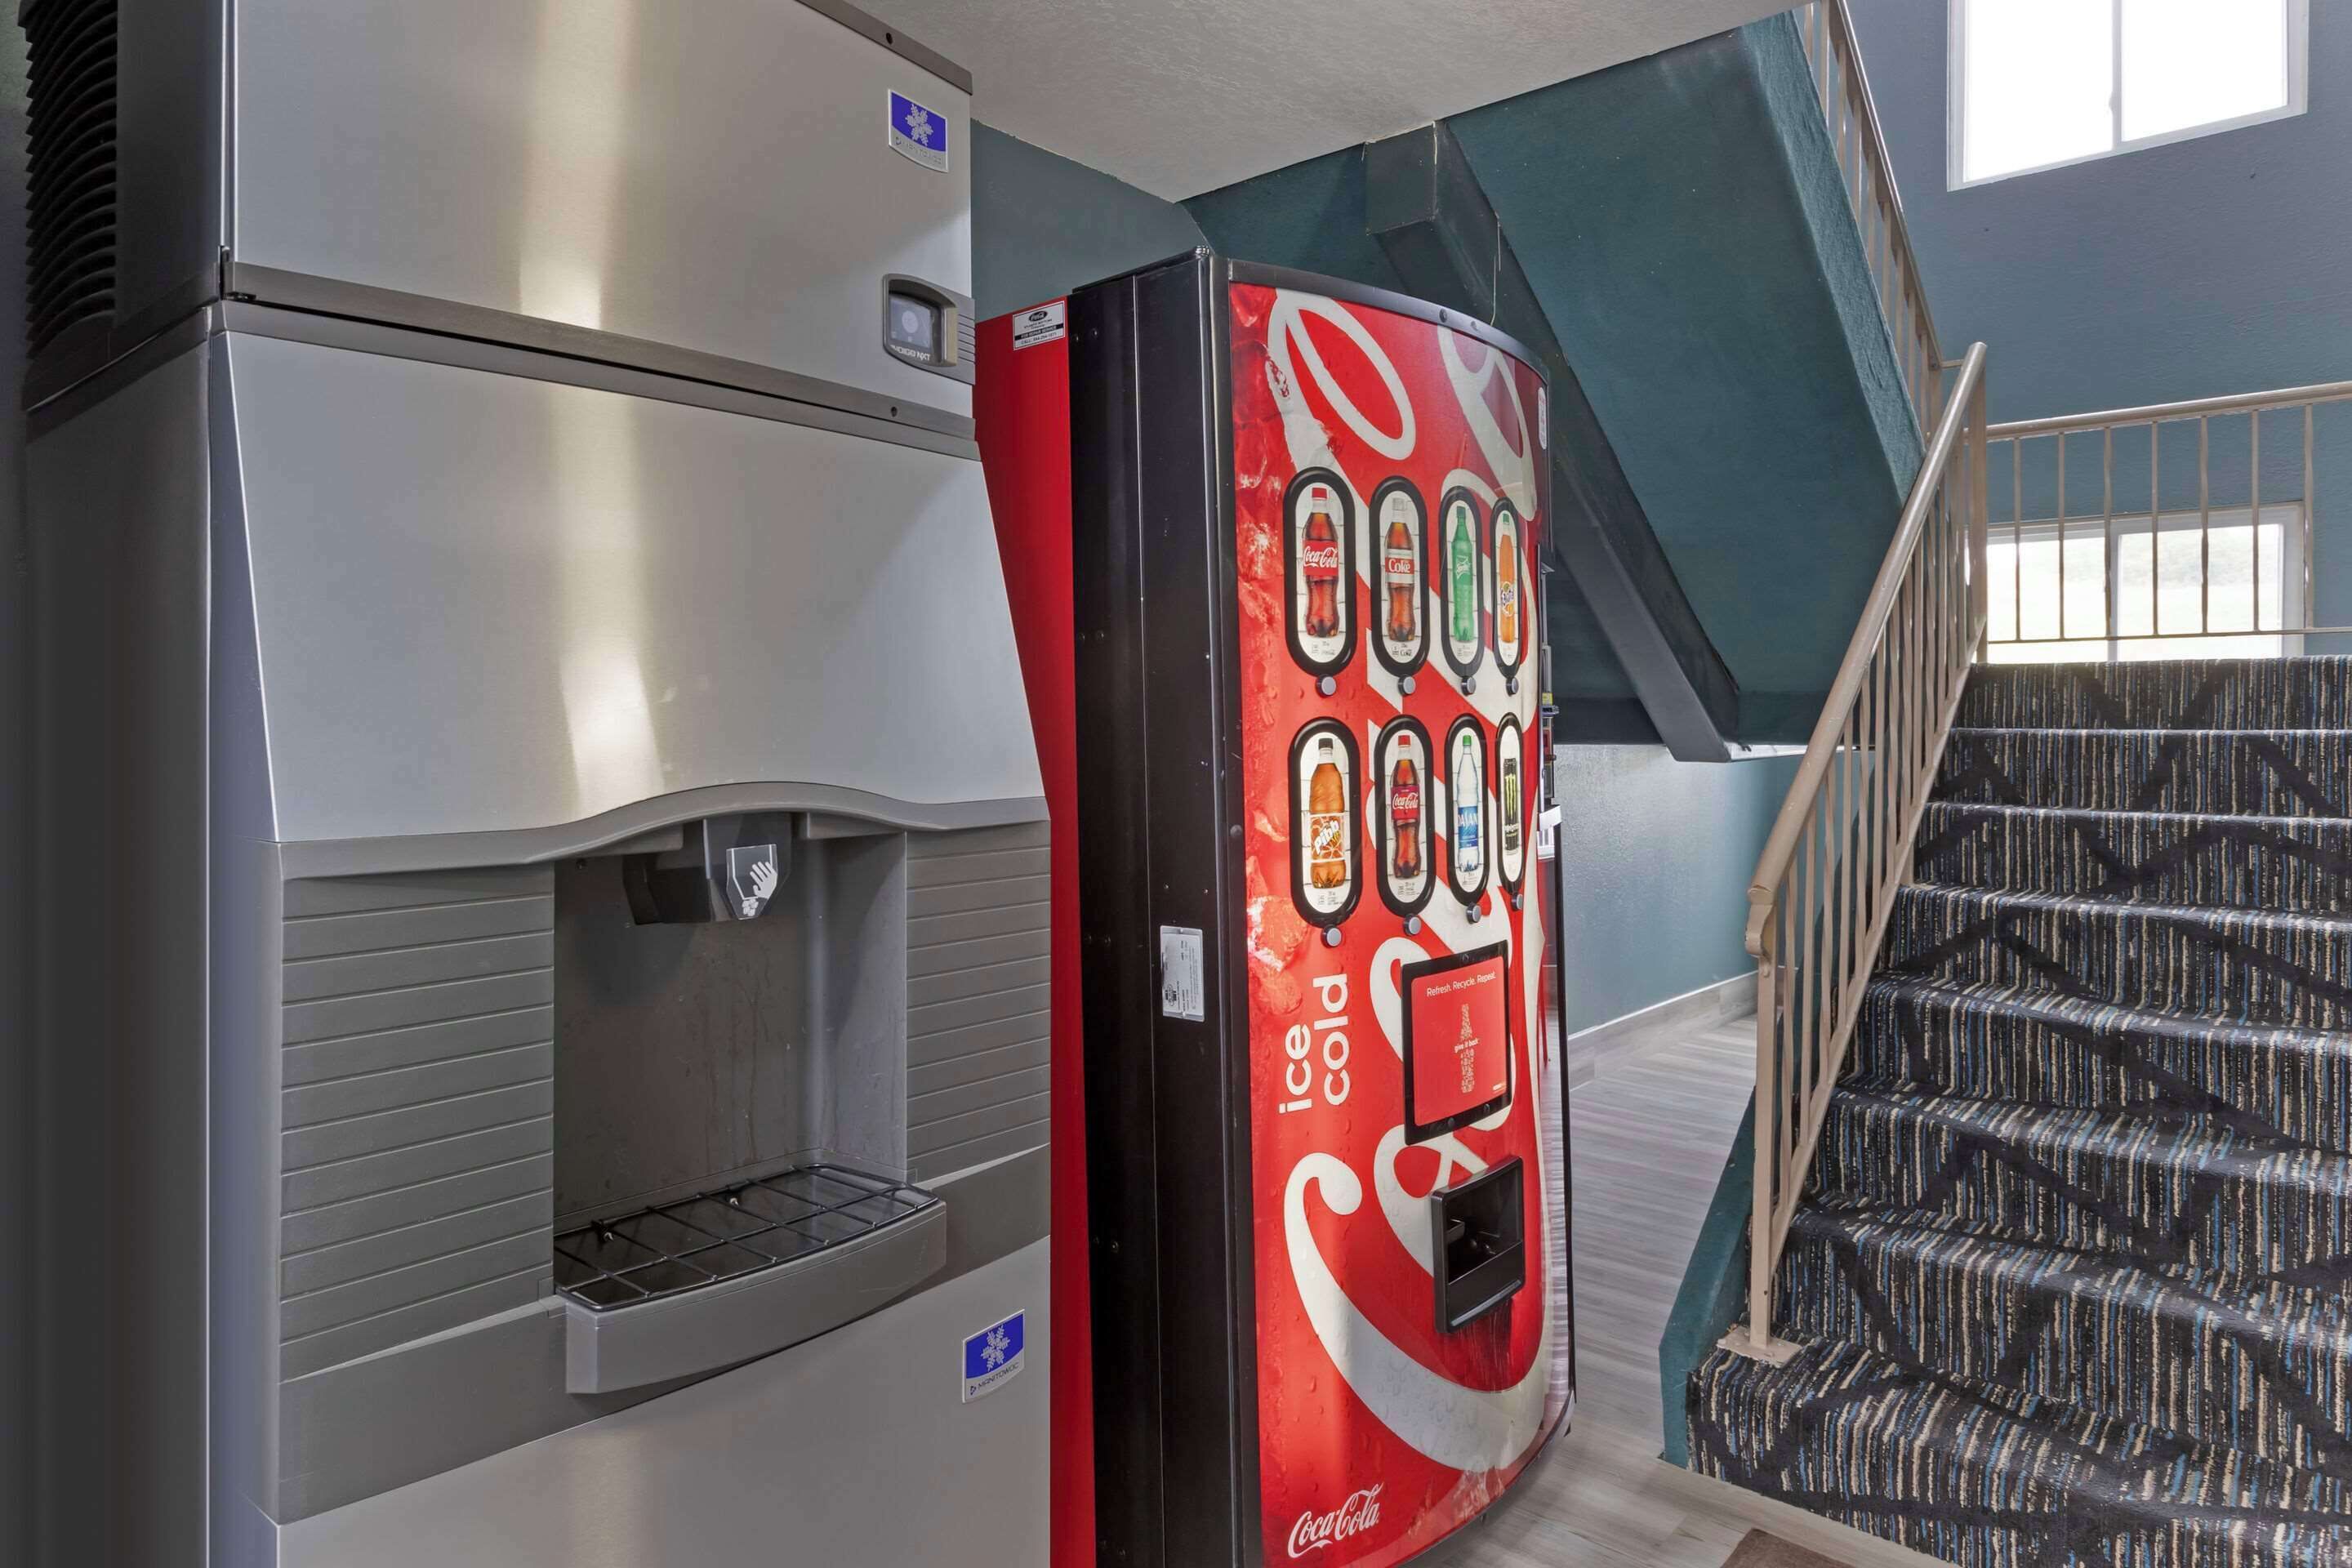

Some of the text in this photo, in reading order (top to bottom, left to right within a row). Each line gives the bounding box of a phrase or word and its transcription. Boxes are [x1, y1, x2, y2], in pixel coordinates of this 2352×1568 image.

[1303, 546, 1338, 568] Coca-Cola
[1388, 559, 1410, 572] Coke
[1392, 791, 1419, 810] Coca-Cola
[1427, 982, 1451, 997] Refresh.
[1453, 977, 1476, 990] Recycle.
[1312, 973, 1351, 1106] cold
[1279, 1024, 1312, 1114] ice
[978, 1362, 1020, 1389] MANITOWOC
[1287, 1482, 1384, 1559] Coca-Cola
